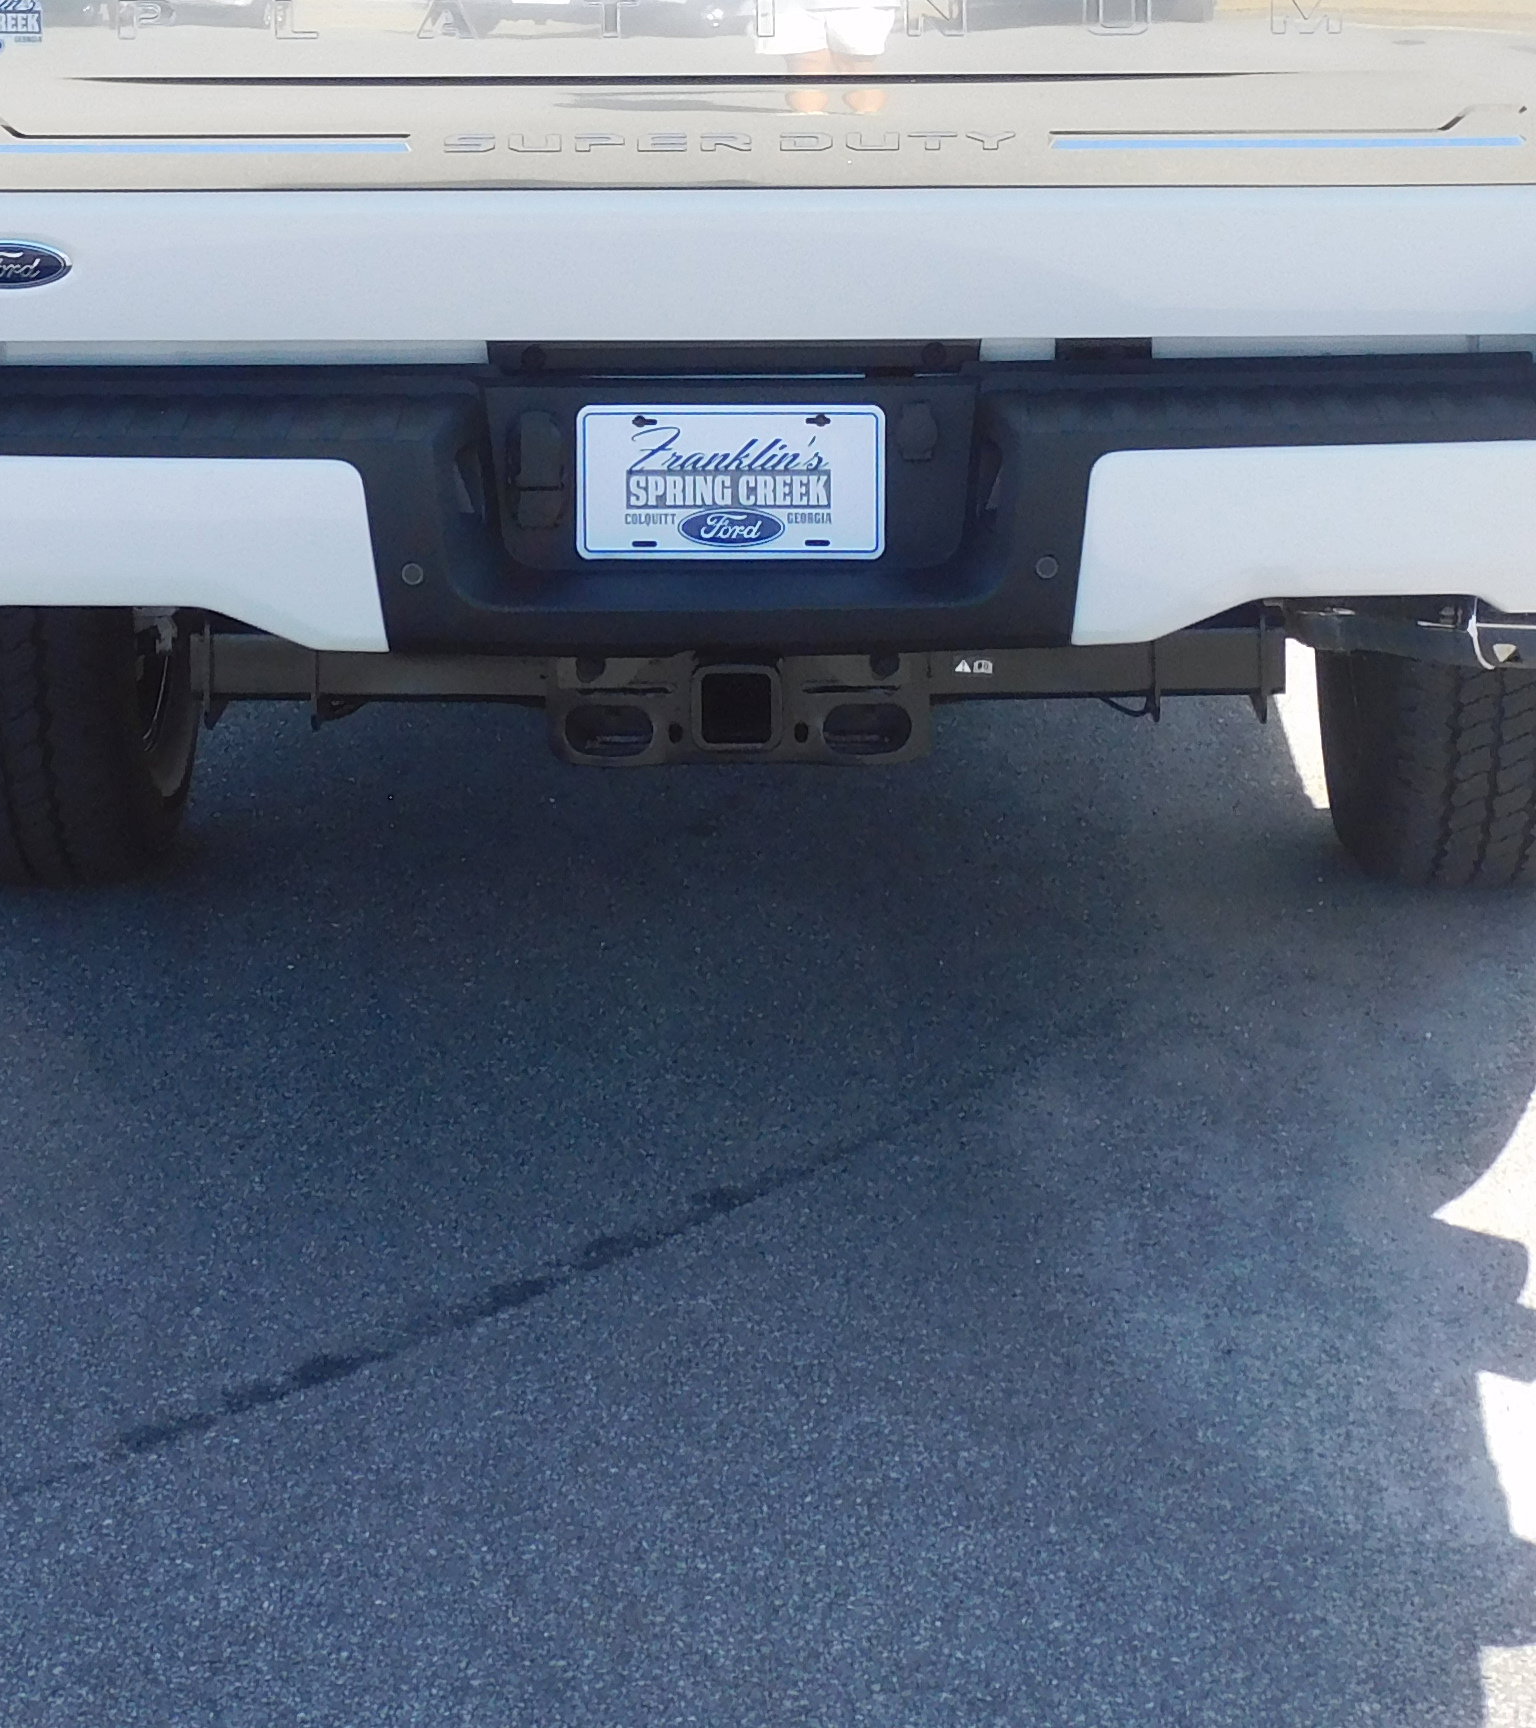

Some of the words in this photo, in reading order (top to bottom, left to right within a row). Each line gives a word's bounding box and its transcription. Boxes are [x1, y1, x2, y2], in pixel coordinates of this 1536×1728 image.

[628, 426, 829, 474] Franklin's
[629, 475, 732, 506] SPRING
[738, 475, 829, 506] CREEK
[625, 513, 677, 526] COLQUITT
[700, 513, 763, 539] Ford
[786, 512, 832, 524] GEORGIA
